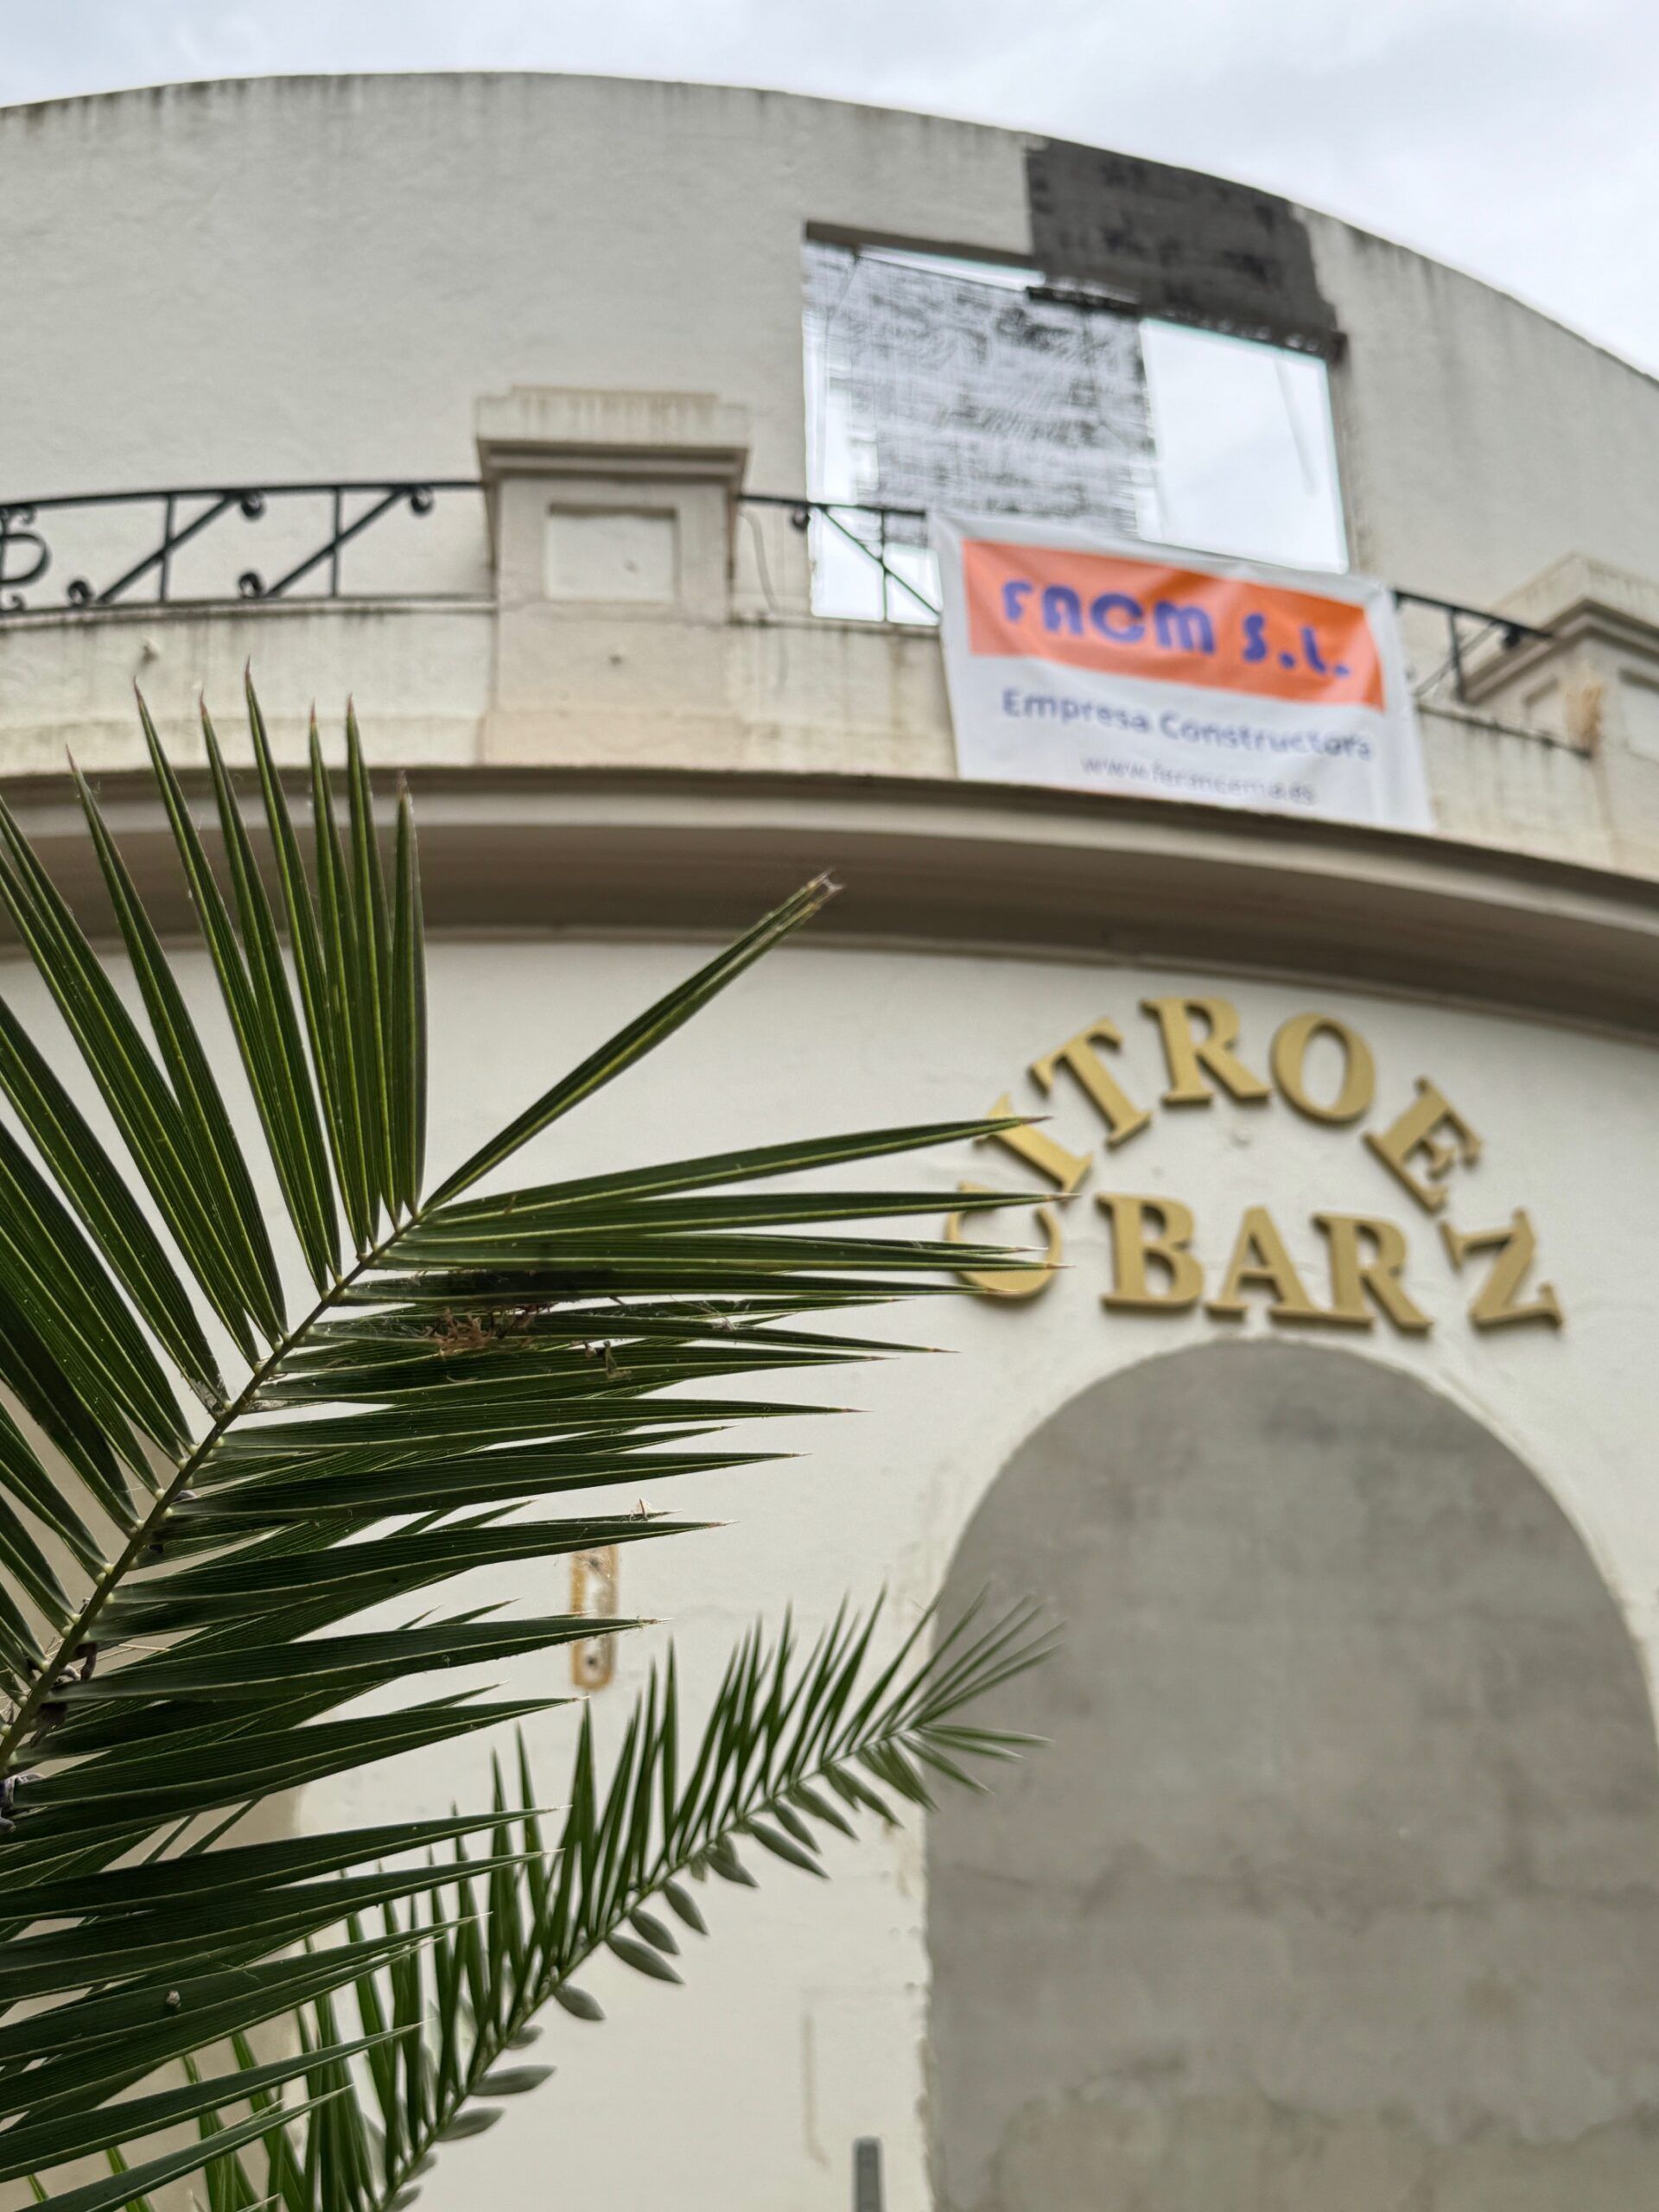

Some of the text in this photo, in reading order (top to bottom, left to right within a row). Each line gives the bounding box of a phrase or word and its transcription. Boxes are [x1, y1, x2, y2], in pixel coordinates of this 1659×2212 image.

[1002, 688, 1371, 762] Empresa Constructora
[1096, 1191, 1433, 1333] BAR
